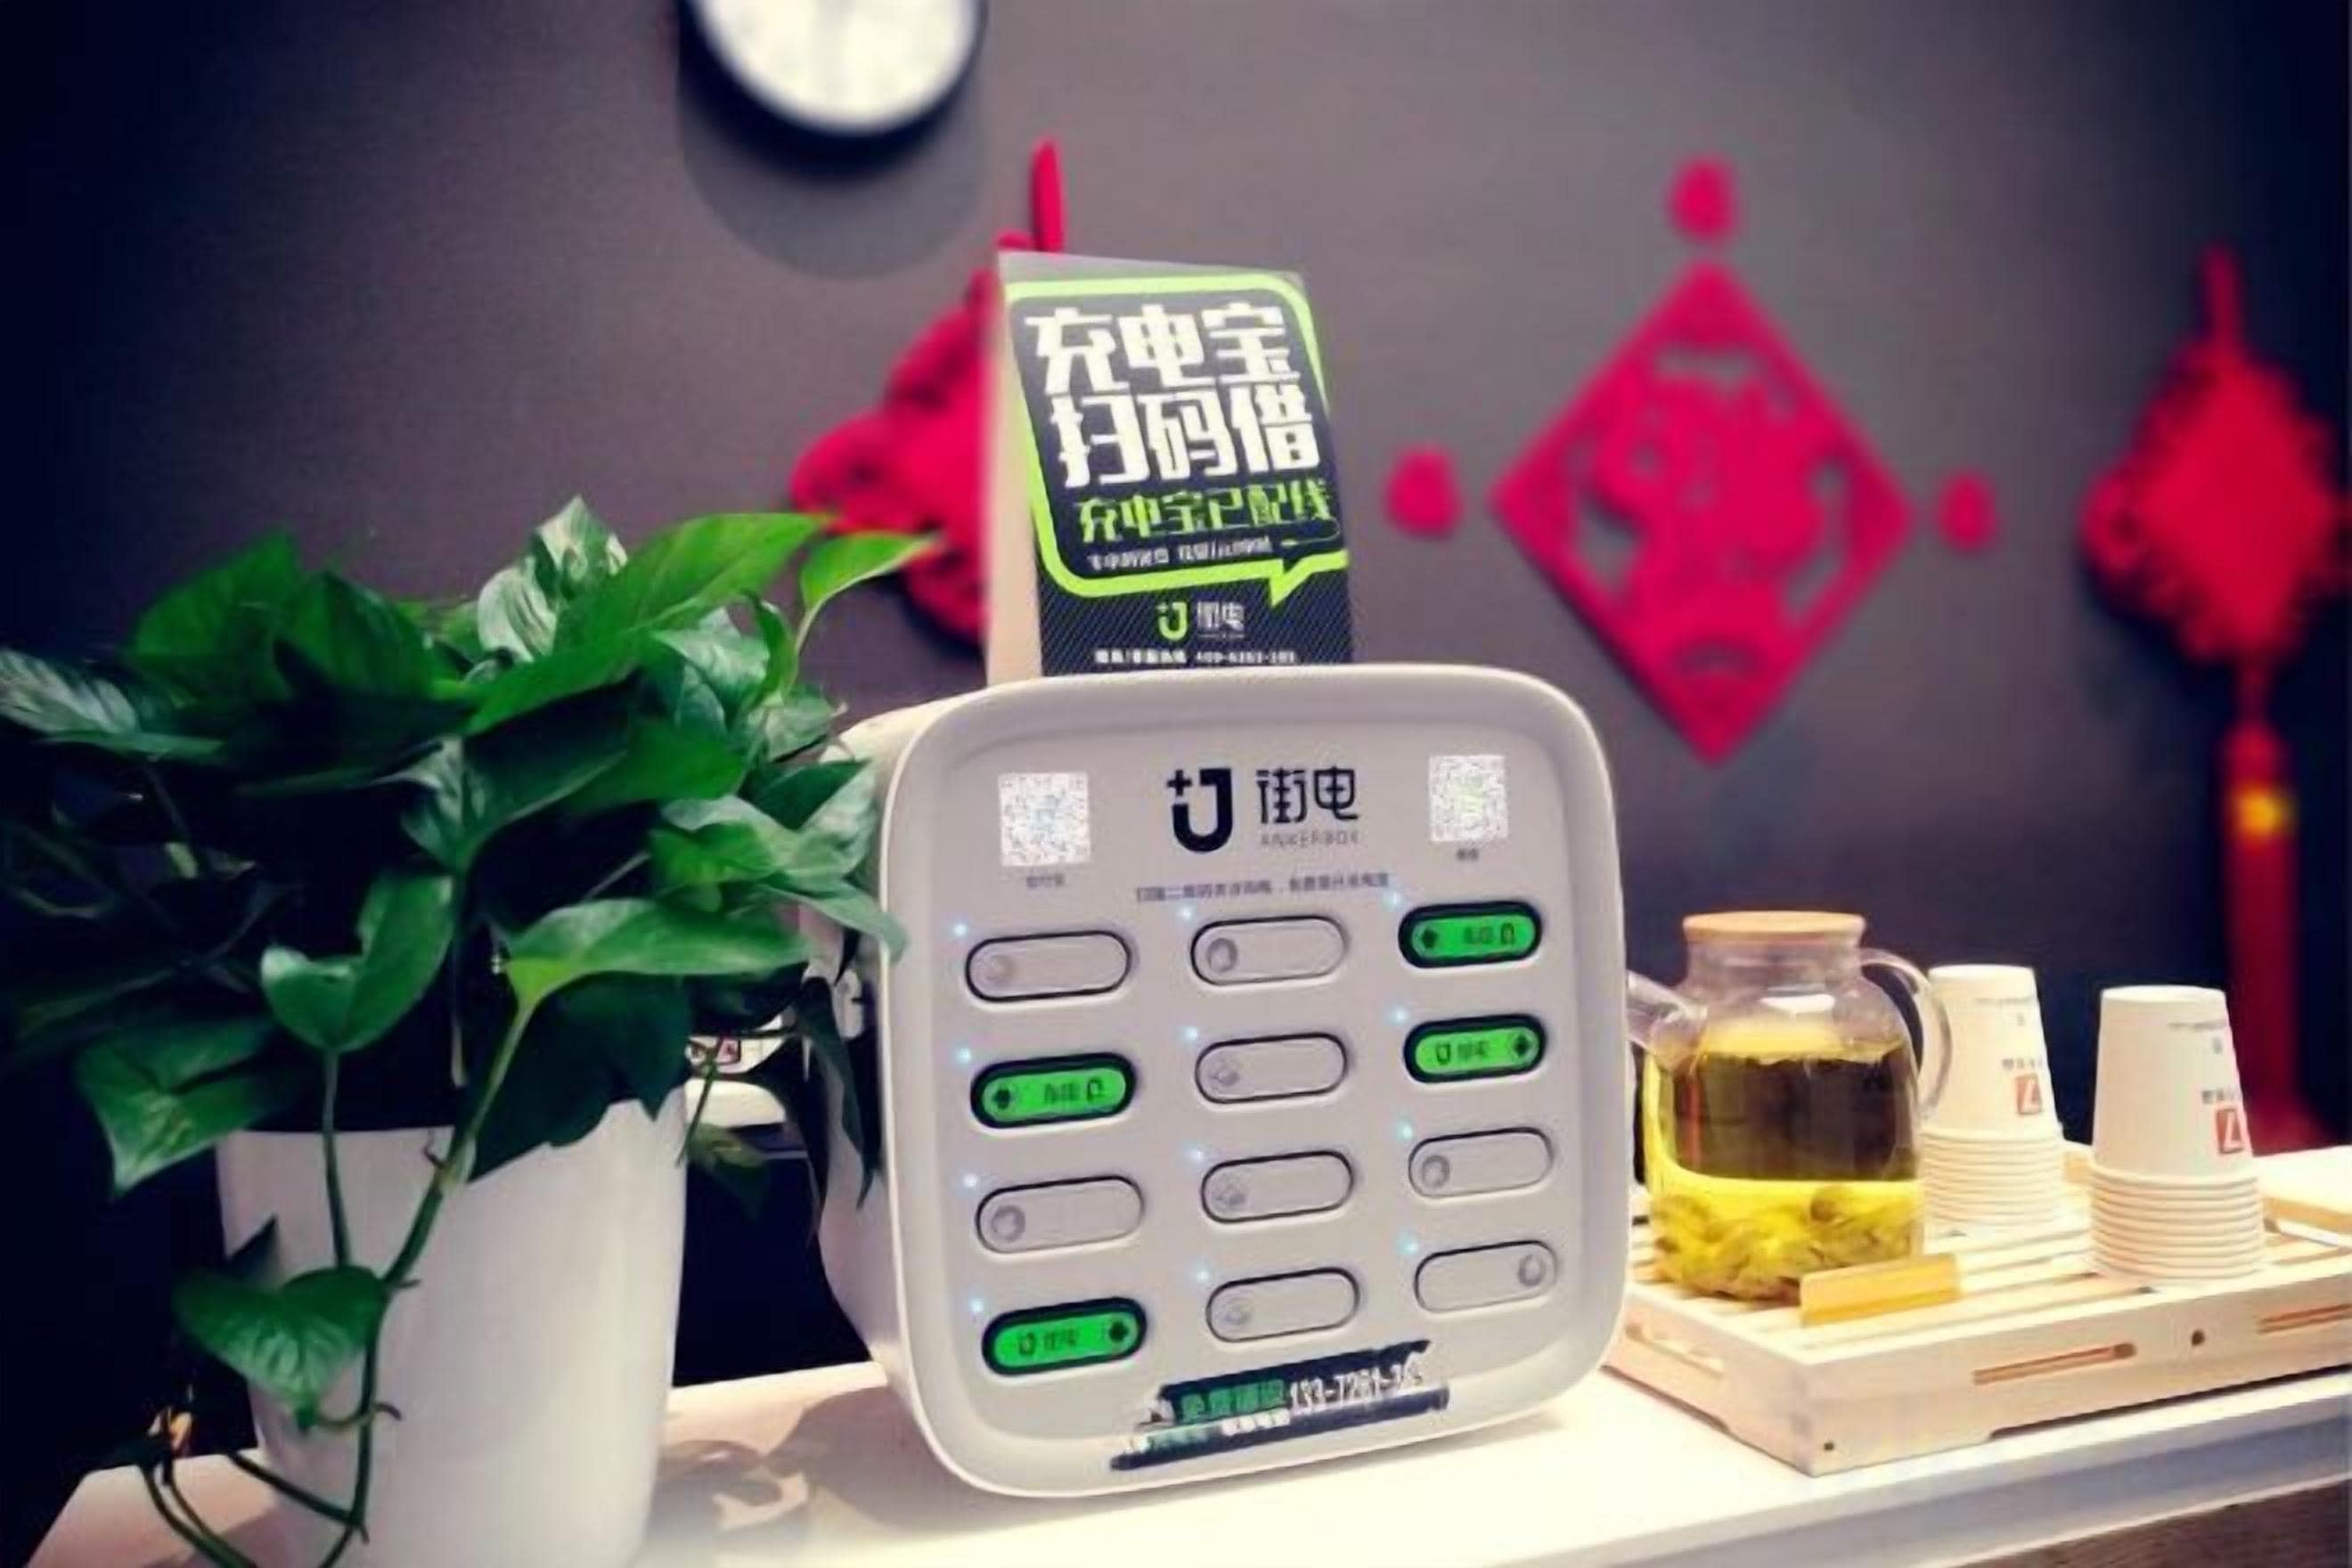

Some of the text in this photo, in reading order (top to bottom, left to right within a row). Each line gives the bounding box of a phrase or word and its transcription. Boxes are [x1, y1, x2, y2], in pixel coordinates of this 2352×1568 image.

[1025, 302, 1300, 396] 充电宝
[1049, 382, 1321, 488] 扫码借
[1074, 478, 1333, 543] 充电宝已配线
[1255, 765, 1360, 824] 街电
